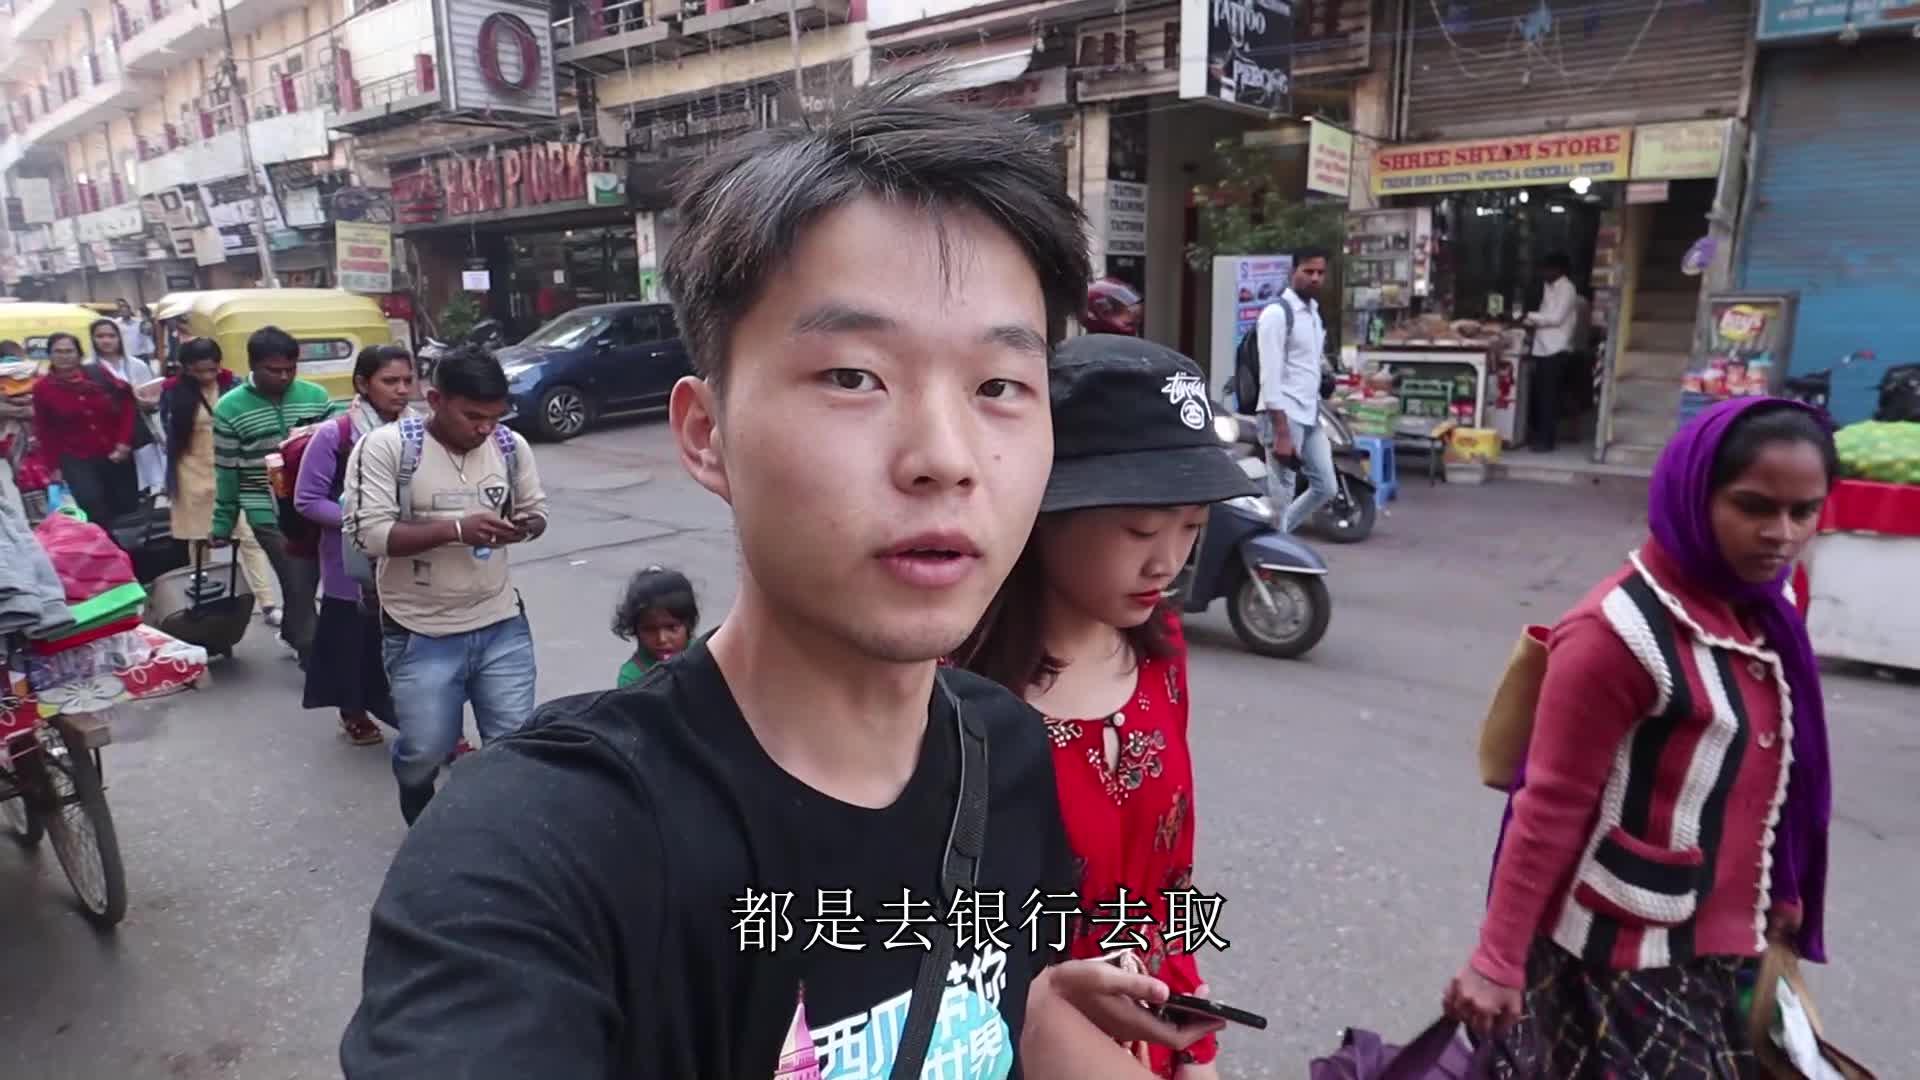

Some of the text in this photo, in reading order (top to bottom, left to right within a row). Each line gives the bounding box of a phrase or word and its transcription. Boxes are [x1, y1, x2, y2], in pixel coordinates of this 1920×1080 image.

[1378, 134, 1622, 172] SHREE SHYAM STORE
